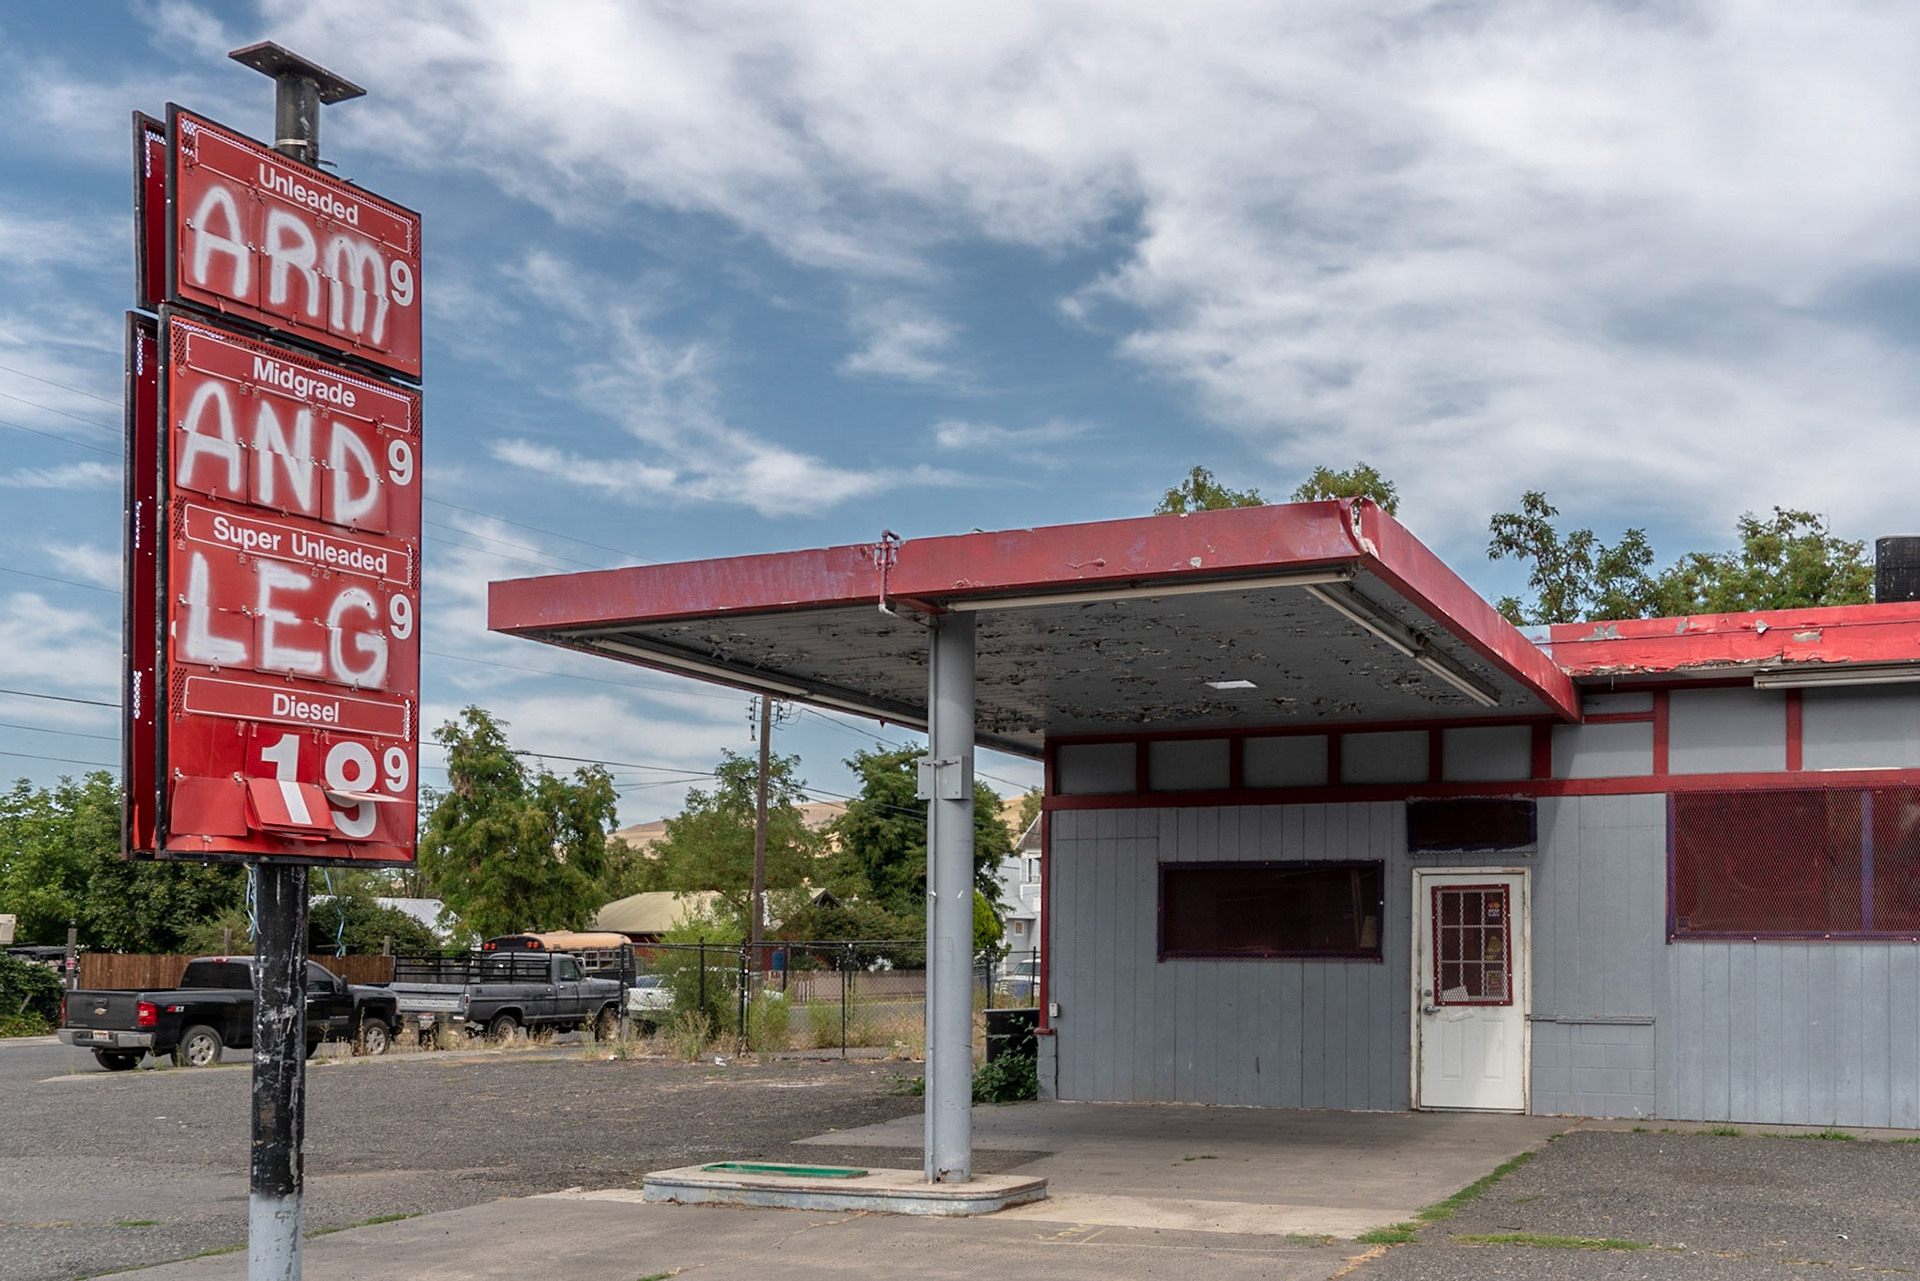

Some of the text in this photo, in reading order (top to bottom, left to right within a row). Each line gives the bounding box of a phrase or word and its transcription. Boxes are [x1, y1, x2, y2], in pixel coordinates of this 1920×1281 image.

[258, 163, 358, 226] Unleaded
[191, 185, 389, 345] ARM
[390, 259, 414, 306] 9
[253, 357, 356, 408] Midgrade
[176, 381, 379, 523] AND
[387, 439, 414, 486] 9
[213, 516, 388, 574] Super Unleaded
[185, 551, 389, 689] LEG
[389, 593, 414, 640] 9
[272, 693, 340, 723] Diesel
[383, 746, 409, 792] 9
